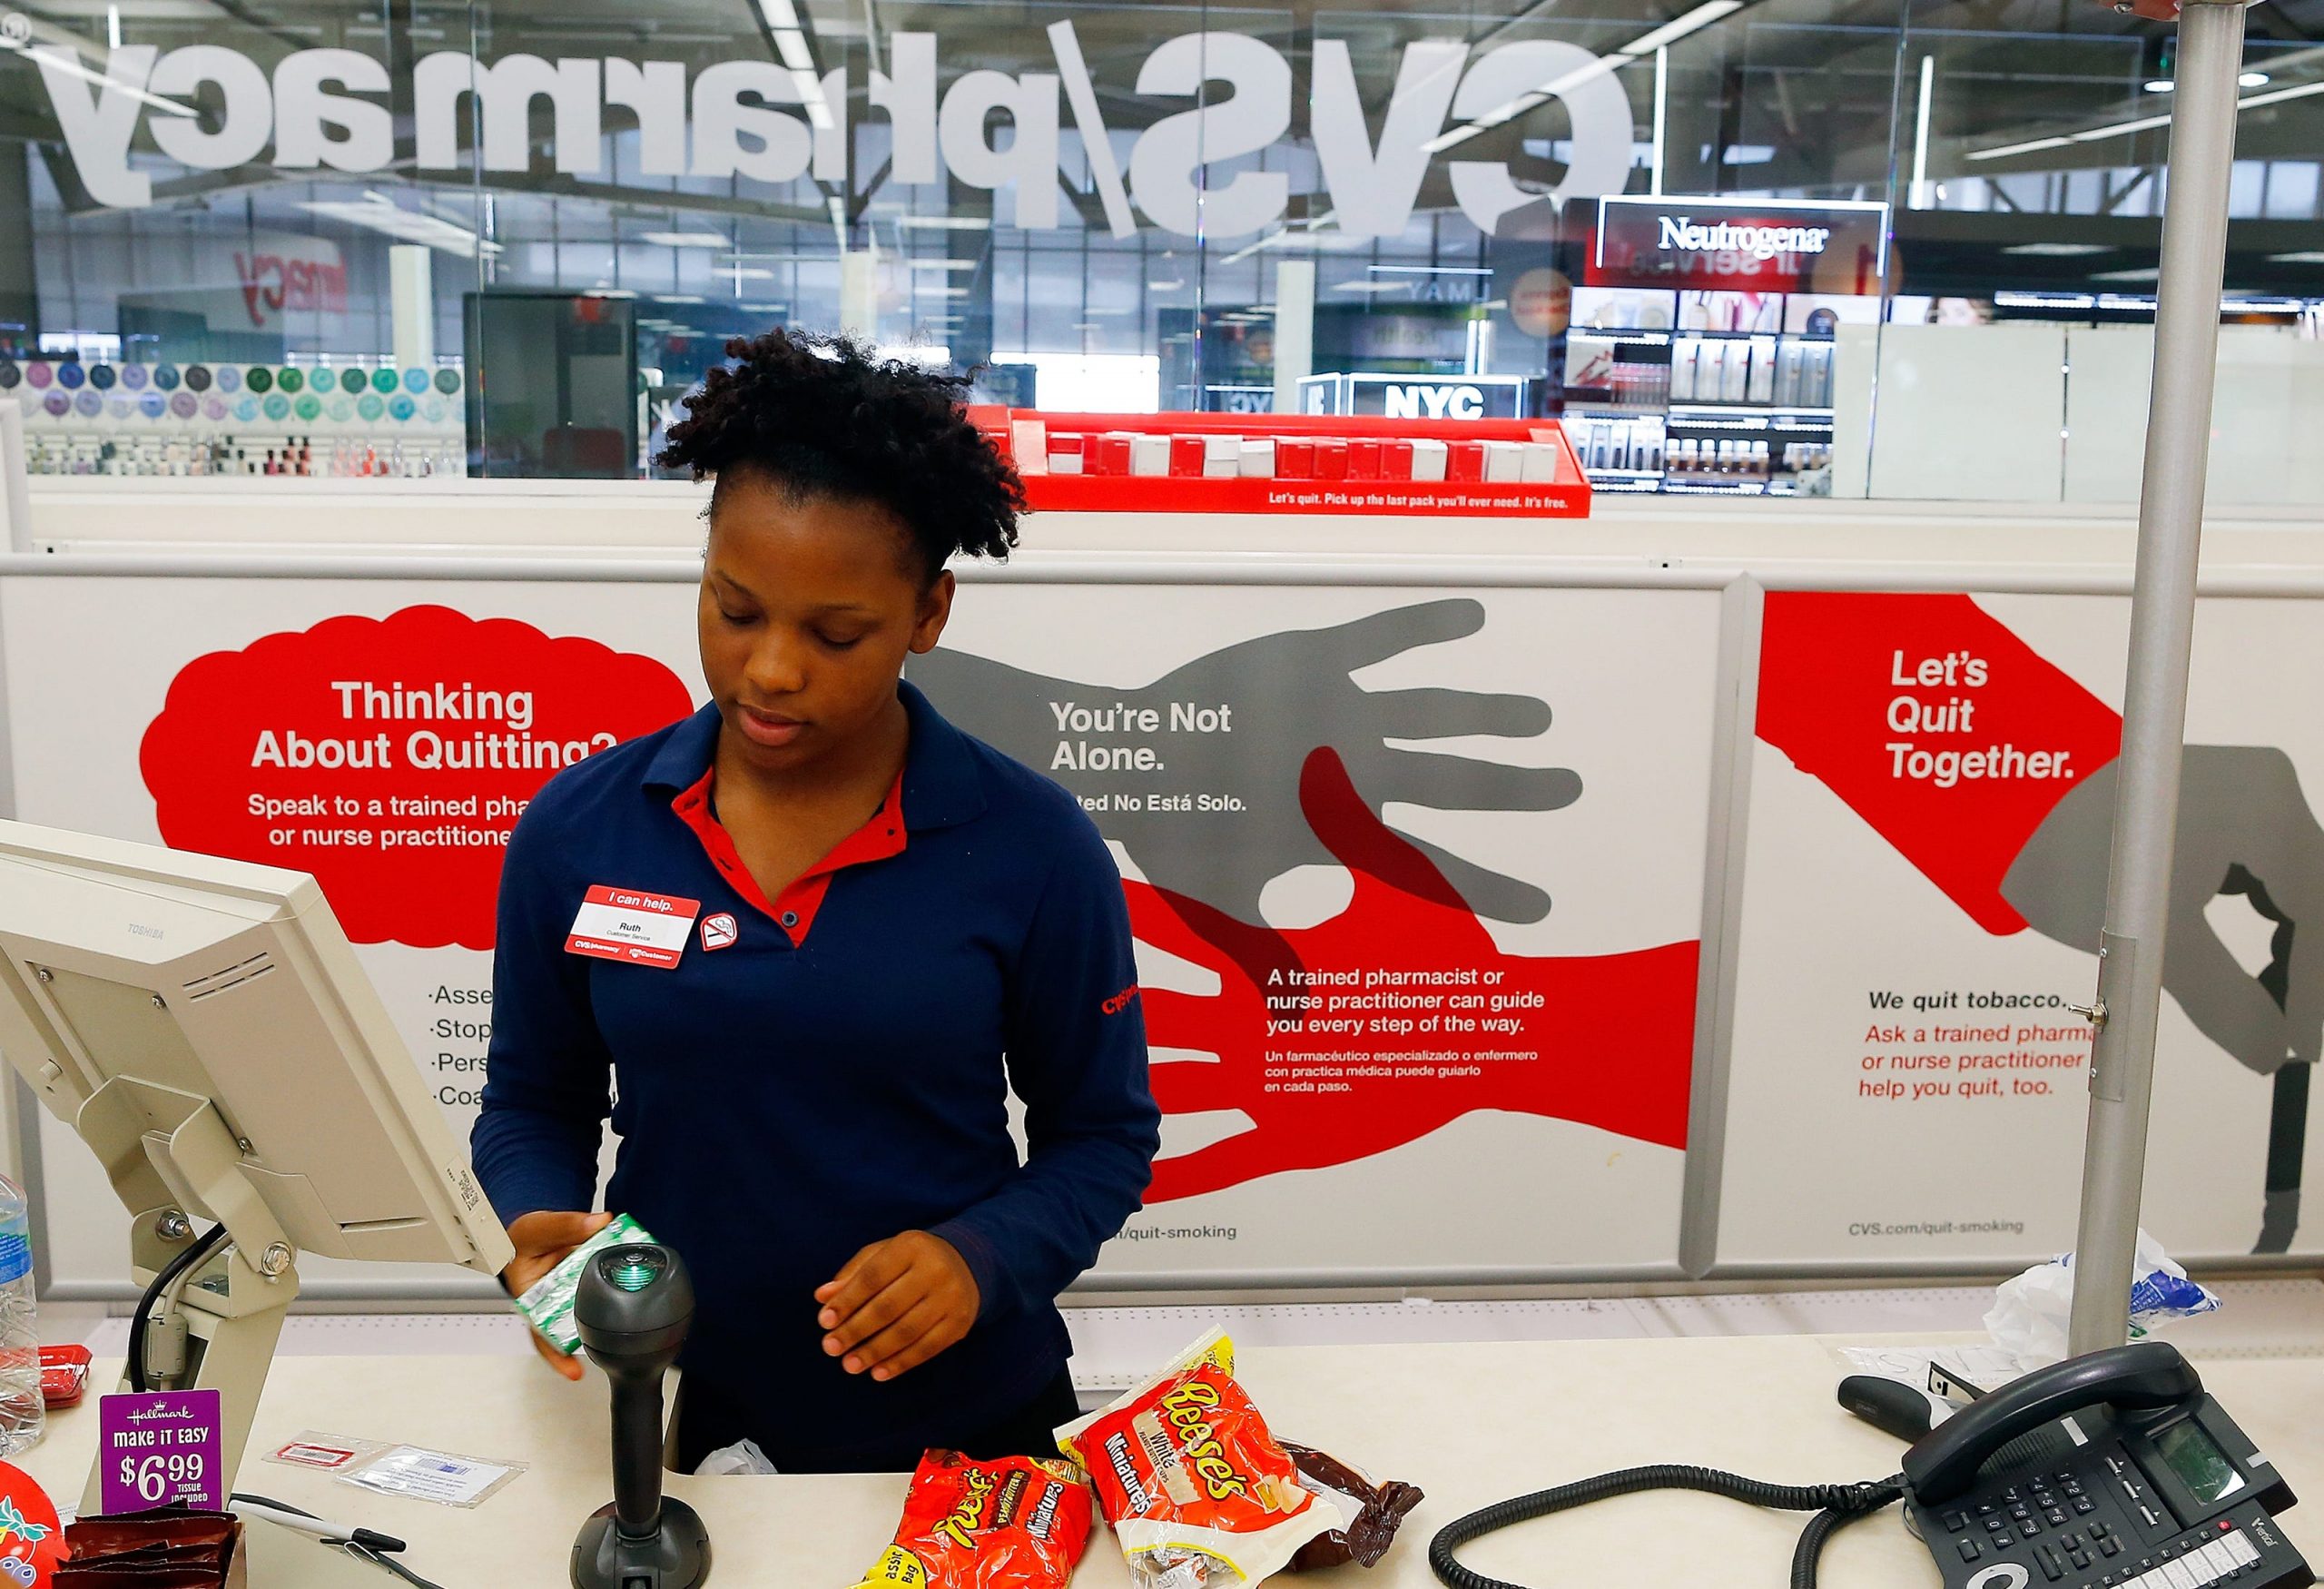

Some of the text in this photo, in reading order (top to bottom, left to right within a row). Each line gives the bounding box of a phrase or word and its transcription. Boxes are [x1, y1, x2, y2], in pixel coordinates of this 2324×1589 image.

[1658, 216, 1827, 260] Neutrogena
[1384, 385, 1484, 420] NYC
[1268, 491, 1569, 508] Let's quit. Pick up the last pack you'll ever need. It's free.
[1891, 650, 1988, 687] Let's
[331, 681, 534, 730] Thinking
[1886, 696, 1974, 734] Quit
[1049, 702, 1232, 732] You're Not
[251, 730, 392, 769] About
[1050, 741, 1164, 771] Alone.
[1885, 742, 2074, 788] Together.
[248, 794, 529, 821] Speak to a trained pha
[1078, 794, 1246, 811] ted No Está Solo.
[269, 825, 513, 851] or nurse practitione
[608, 891, 674, 913] I can help.
[128, 923, 164, 941] TOSHIBA
[606, 929, 651, 942] Customer Service
[619, 923, 642, 933] Ruth
[1267, 967, 1504, 989] A trained pharmacist or
[435, 985, 493, 1004] Asse
[1266, 991, 1545, 1012] nurse practitioner can guide
[1868, 992, 2067, 1012] We quit tobacco.
[1266, 1015, 1525, 1037] you every step of the way.
[1865, 1024, 1906, 1042] Ask
[1913, 1029, 1926, 1042] a
[1935, 1024, 2011, 1042] trained
[438, 1052, 487, 1071] Pers
[1265, 1049, 1539, 1063] Un farmacéutico especializado o enfermero
[1862, 1051, 2084, 1071] or nurse practitioner
[1265, 1064, 1482, 1080] con practica médica puede guiarlo
[439, 1086, 483, 1105] Coa
[1264, 1081, 1353, 1094] en cada paso.
[1859, 1078, 2053, 1100] help you quit, too.
[1848, 1219, 2024, 1237] CVS.com/quit-smoking
[127, 1406, 194, 1426] Hallmark
[1149, 1431, 1175, 1468] White
[1162, 1382, 1247, 1499] Reese's
[1105, 1432, 1151, 1514] Miniatures
[901, 1564, 919, 1584] Bag
